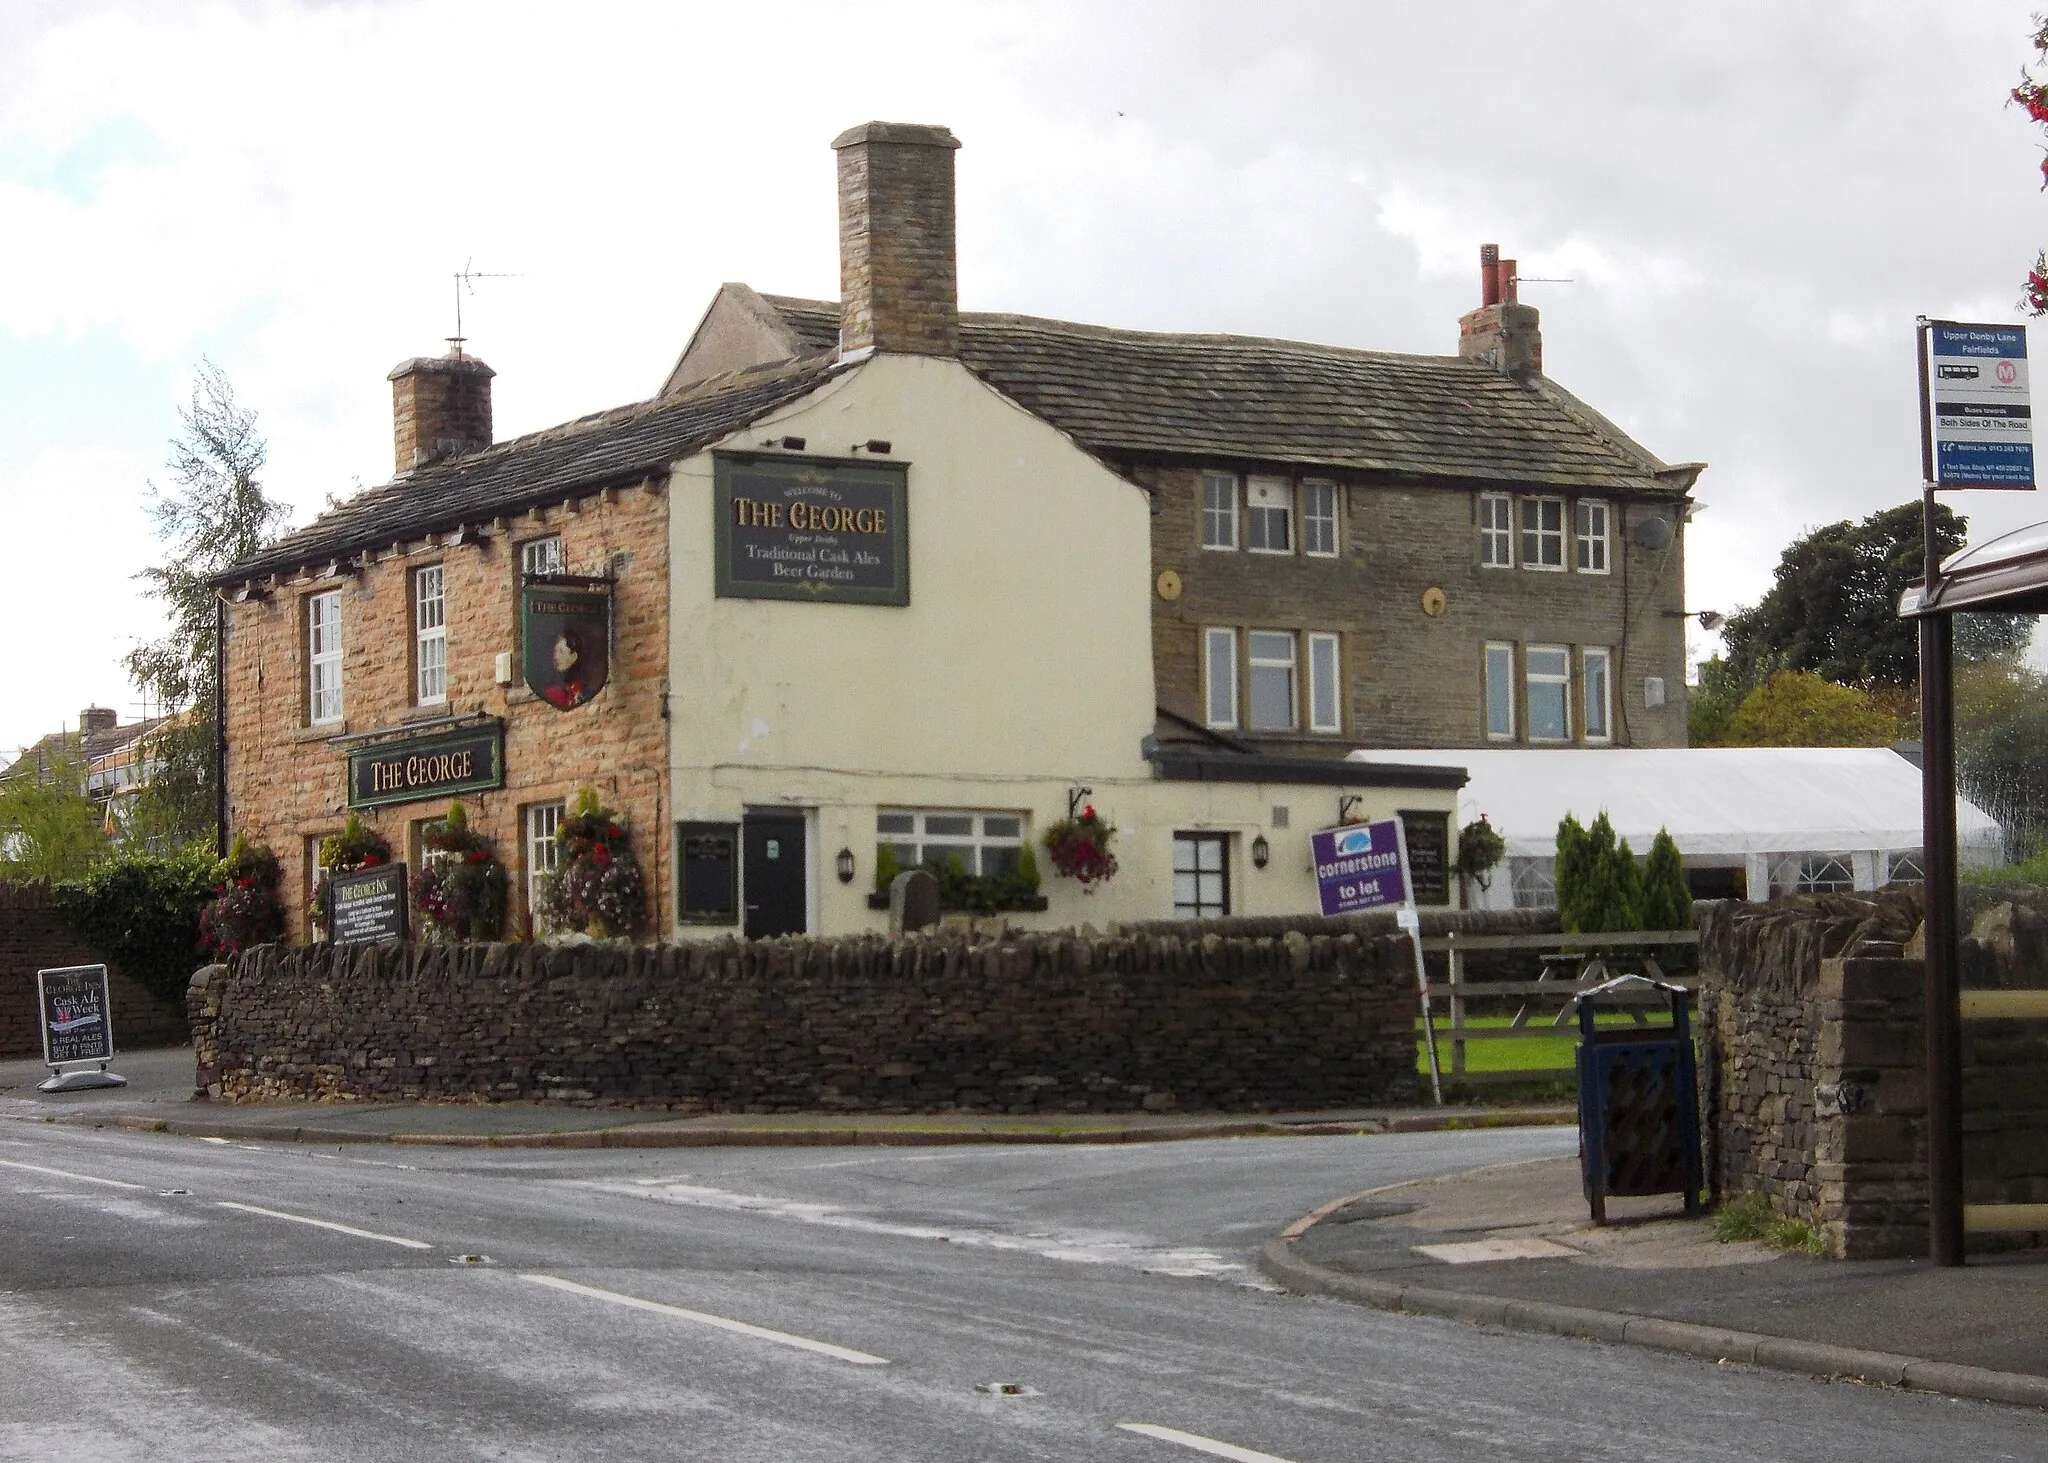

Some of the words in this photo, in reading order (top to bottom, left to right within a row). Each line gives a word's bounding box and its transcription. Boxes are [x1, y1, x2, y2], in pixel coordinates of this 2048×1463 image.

[1943, 331, 1968, 341] Upper
[1970, 332, 1995, 343] Denby
[1997, 333, 2017, 342] Lane
[1962, 345, 2000, 354] Fairfields
[1940, 419, 1958, 427] Both
[1959, 419, 1980, 427] Sides
[1981, 420, 1990, 428] Of
[1993, 420, 2006, 428] The
[2008, 421, 2028, 429] Road
[783, 486, 828, 498] WELCOME
[829, 490, 842, 501] TO
[733, 497, 784, 528] THE
[789, 501, 888, 534] GEORGE
[787, 533, 813, 545] Upper
[746, 544, 816, 561] Traditional
[819, 549, 850, 564] Cask
[852, 550, 881, 565] Ales
[772, 562, 803, 577] Beer
[806, 564, 855, 580] Garden
[536, 602, 556, 613] THE
[370, 761, 403, 792] THE
[406, 750, 473, 786] GEORGE
[1319, 851, 1397, 879] cornerstone
[341, 886, 354, 901] THE
[1339, 885, 1356, 900] to
[1359, 879, 1380, 895] let
[53, 995, 78, 1007] Cask
[81, 989, 100, 1004] Ale
[72, 1002, 100, 1014] Week
[59, 1035, 80, 1044] REAL
[82, 1033, 102, 1041] ALES
[52, 1044, 70, 1053] BUY
[53, 1051, 70, 1059] GET
